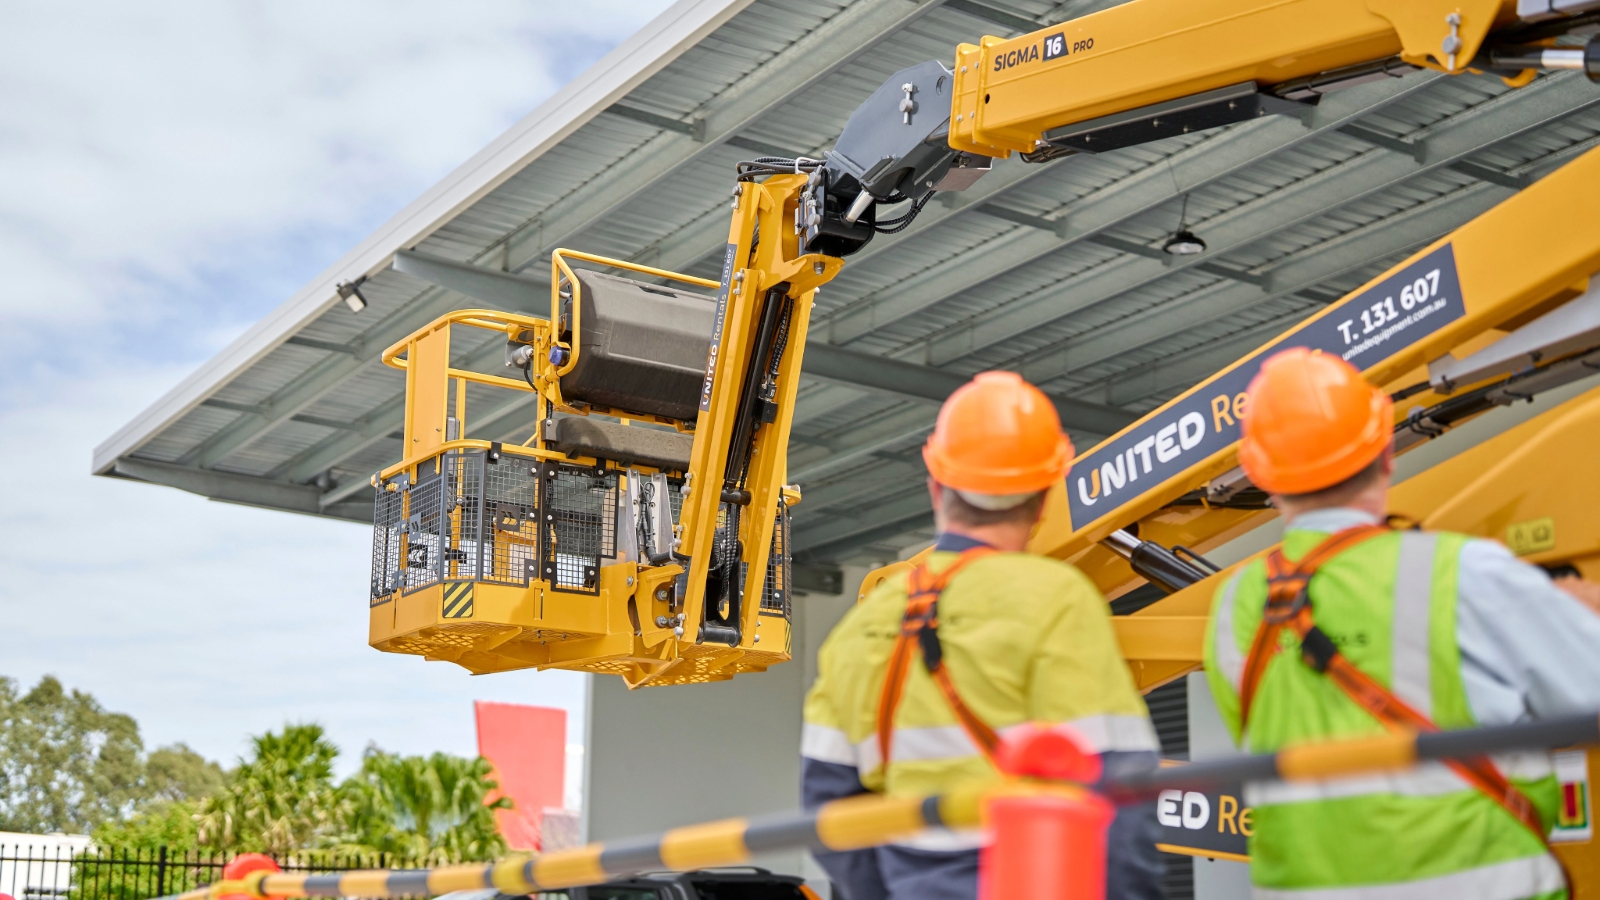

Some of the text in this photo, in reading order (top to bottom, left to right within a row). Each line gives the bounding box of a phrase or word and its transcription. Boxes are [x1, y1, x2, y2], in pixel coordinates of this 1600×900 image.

[993, 36, 1094, 72] SIGMA 16 PRO
[1337, 268, 1441, 345] T. 131 607
[1341, 297, 1447, 361] unitedequipment.com.au
[702, 344, 718, 406] UNITED
[713, 294, 727, 341] Rentals
[1077, 411, 1206, 506] UNITED
